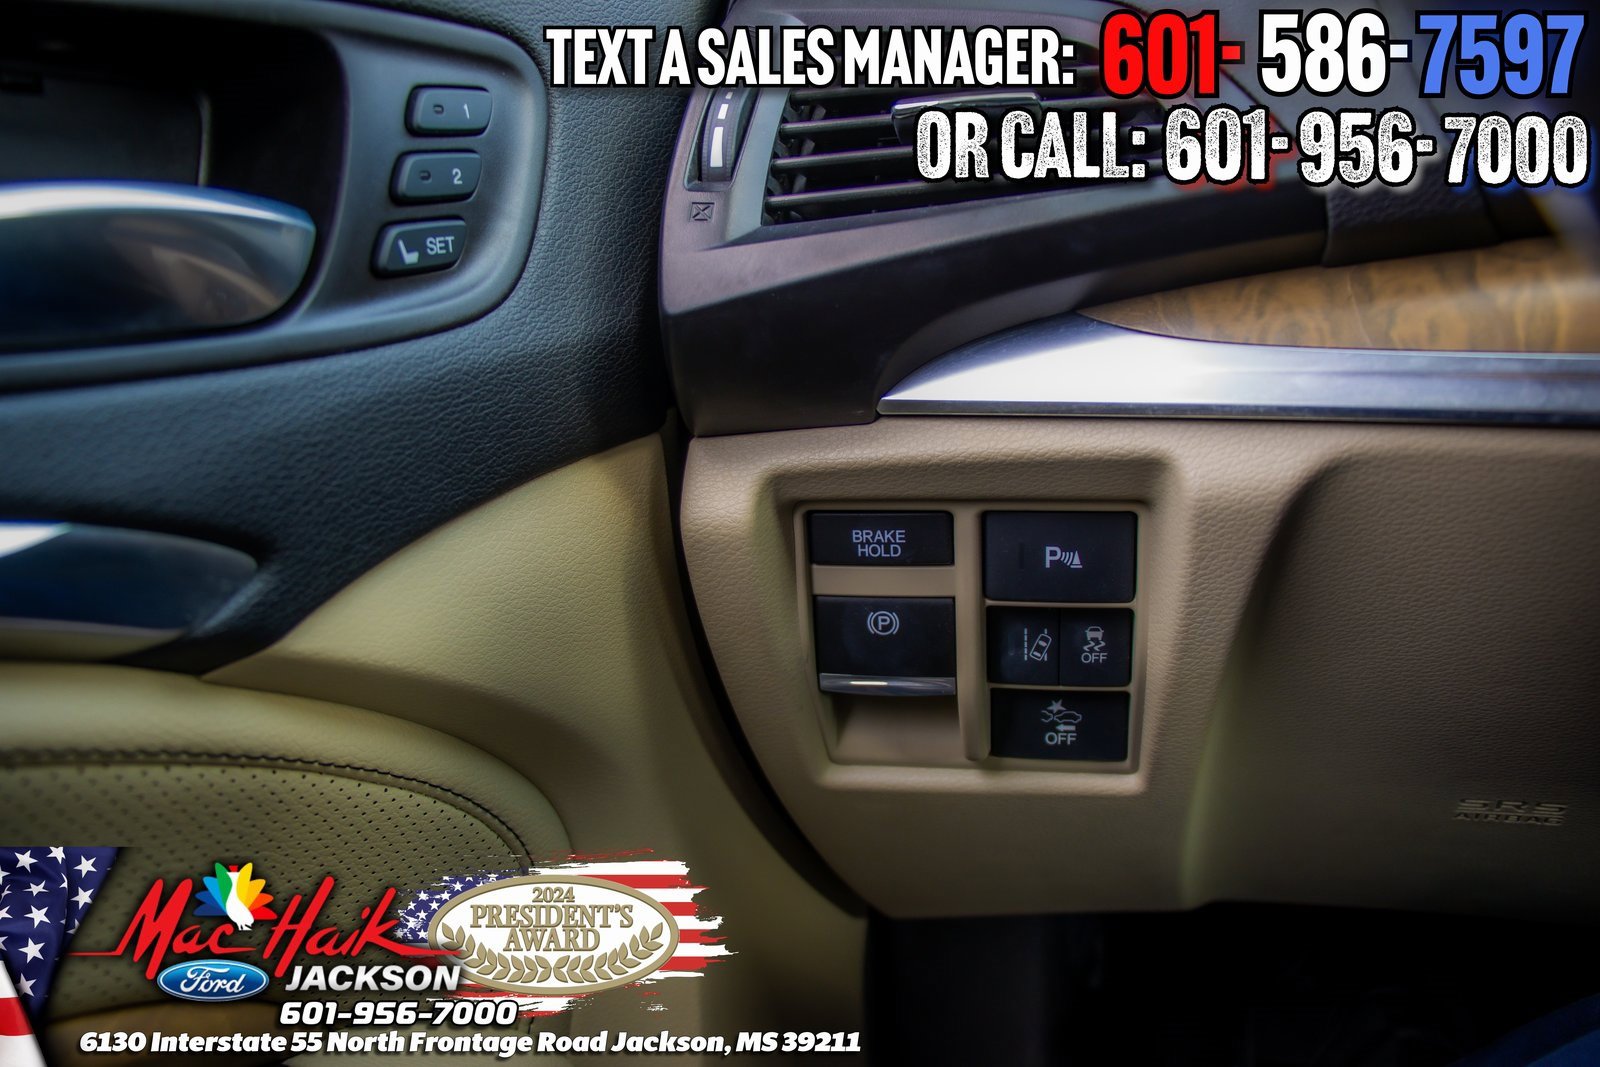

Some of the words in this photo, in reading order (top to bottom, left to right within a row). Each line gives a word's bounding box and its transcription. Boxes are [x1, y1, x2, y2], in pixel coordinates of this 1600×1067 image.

[463, 103, 470, 119] 1
[452, 168, 463, 184] 2
[426, 236, 455, 255] SET
[852, 529, 906, 543] BRAKE
[858, 544, 901, 558] HOLD
[1081, 652, 1108, 664] OFF
[1045, 732, 1077, 745] OFF
[1457, 799, 1568, 815] SRS
[1453, 812, 1565, 826] AIRBAG
